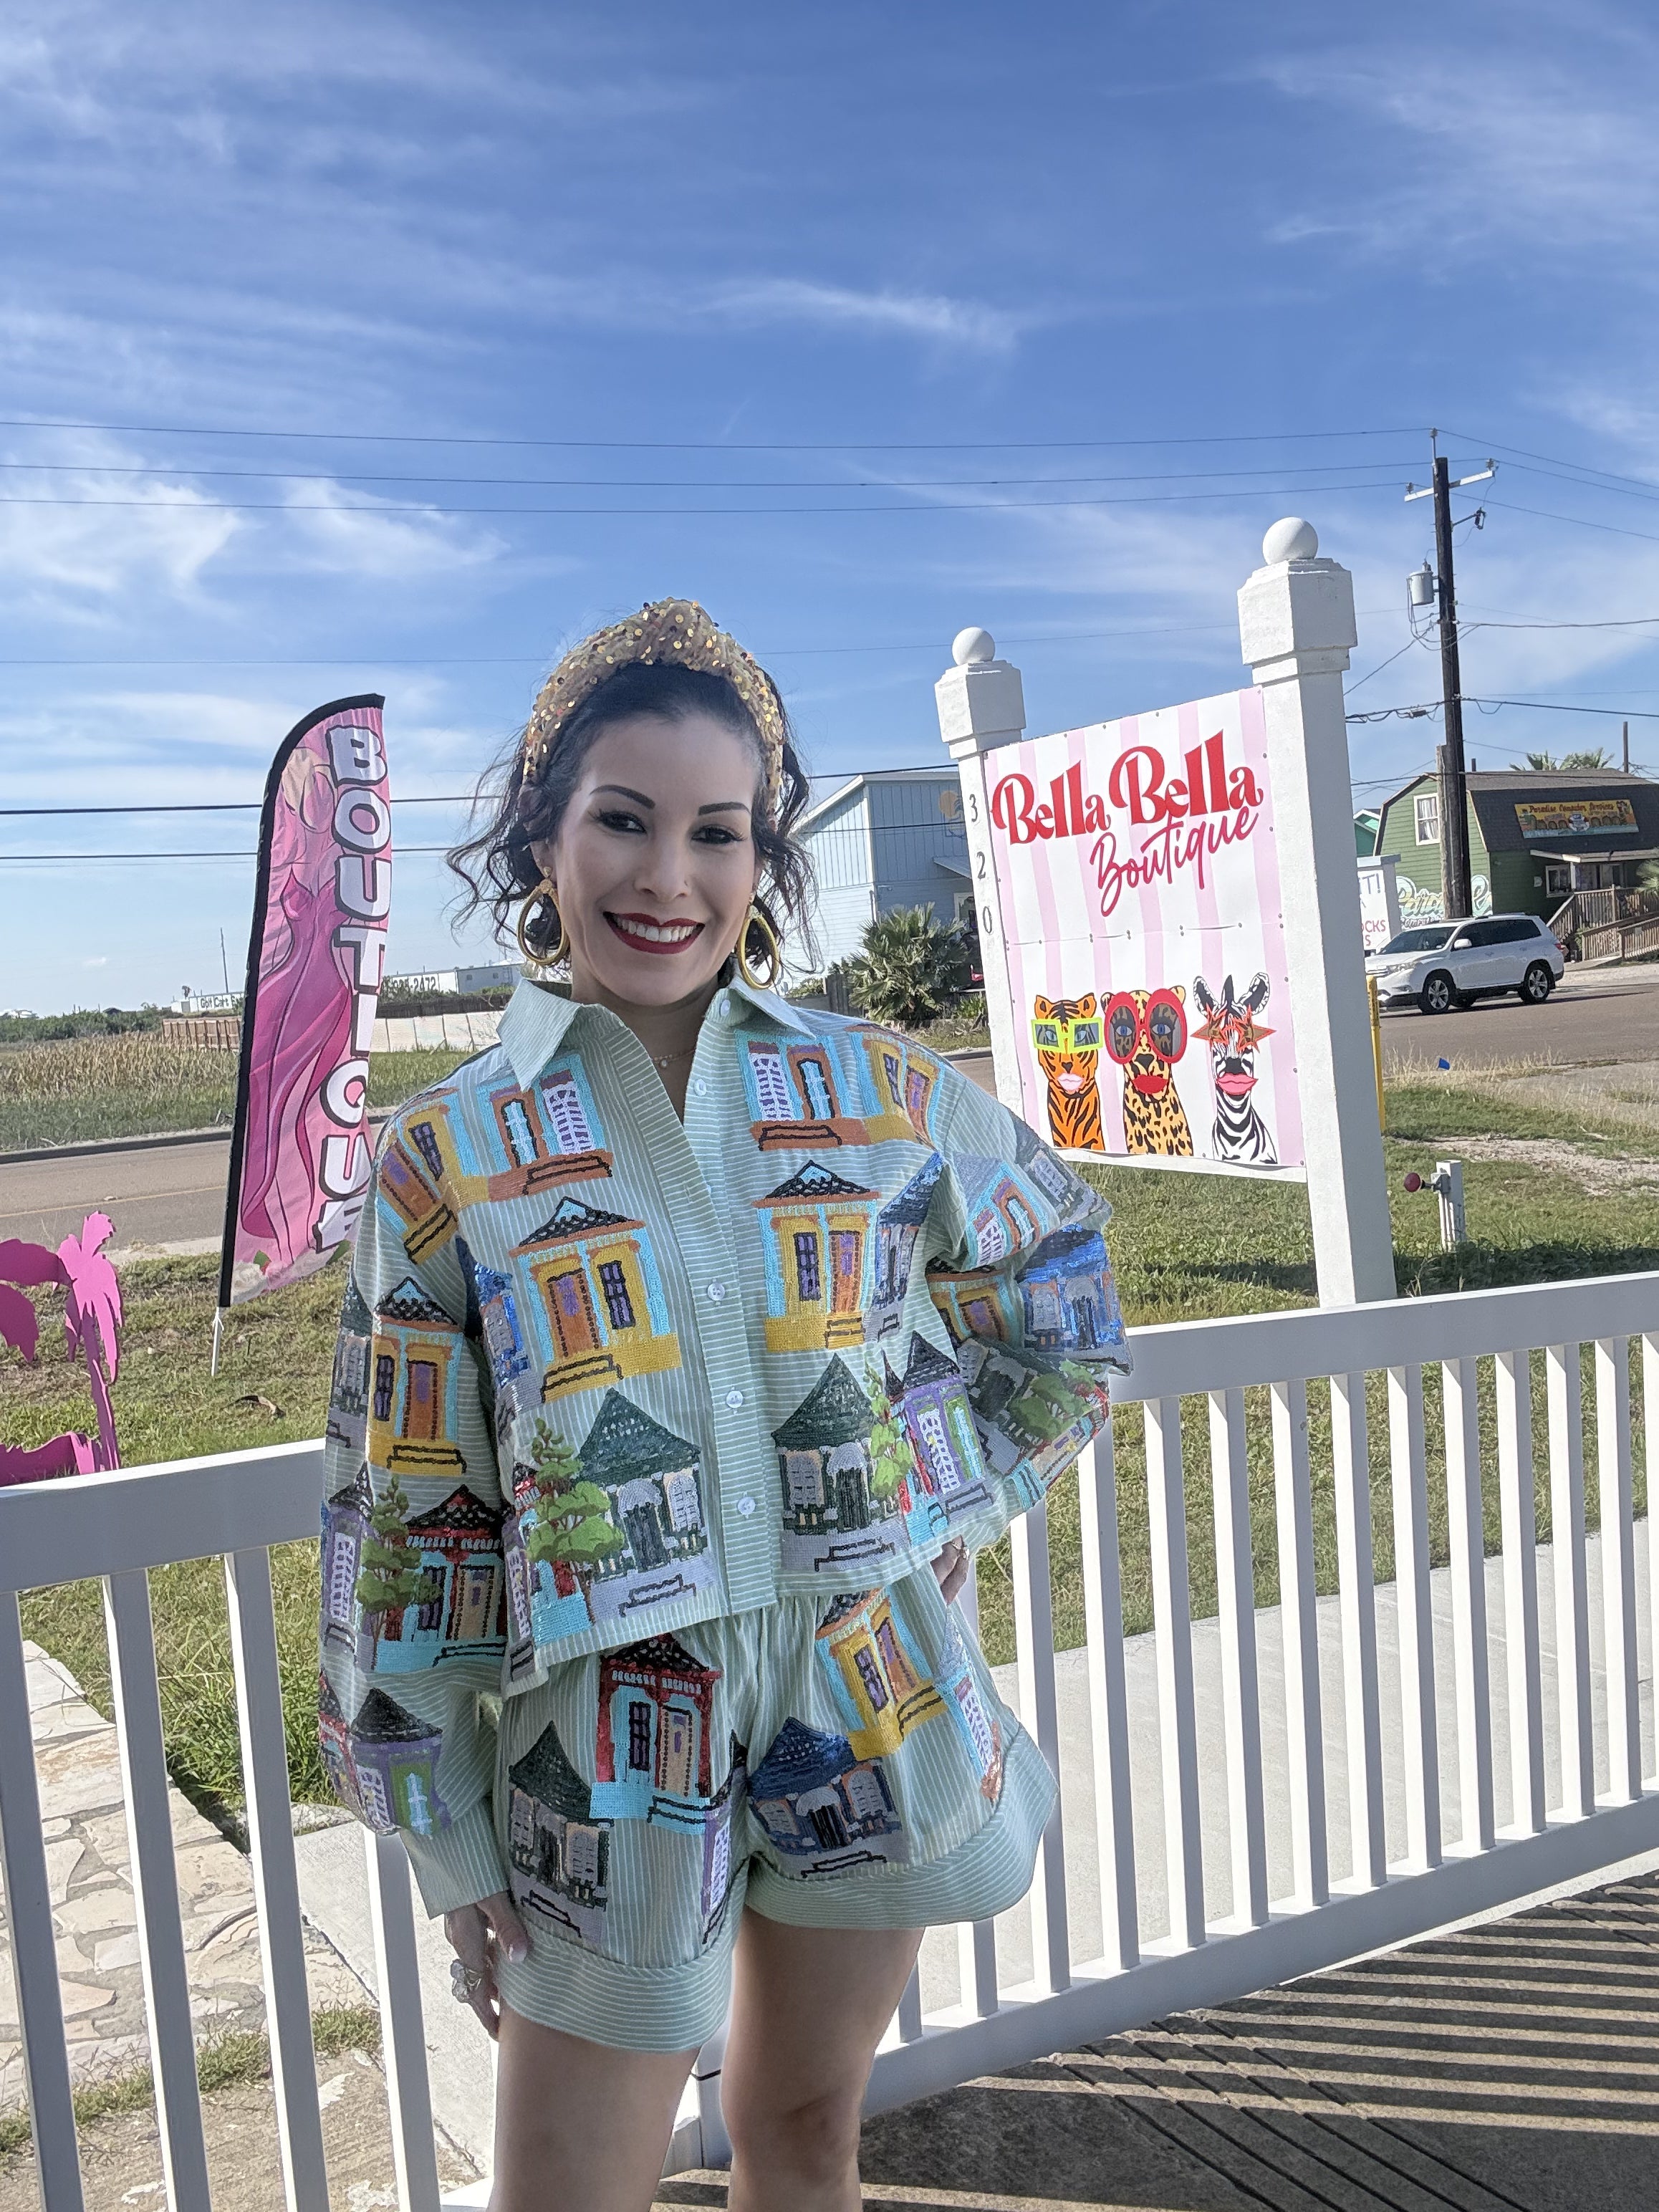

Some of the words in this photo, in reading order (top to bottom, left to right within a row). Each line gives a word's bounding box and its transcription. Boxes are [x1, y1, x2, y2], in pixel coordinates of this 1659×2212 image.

[991, 759, 1111, 845] Bella
[1109, 728, 1264, 825] Bella
[1090, 806, 1259, 918] Boutique
